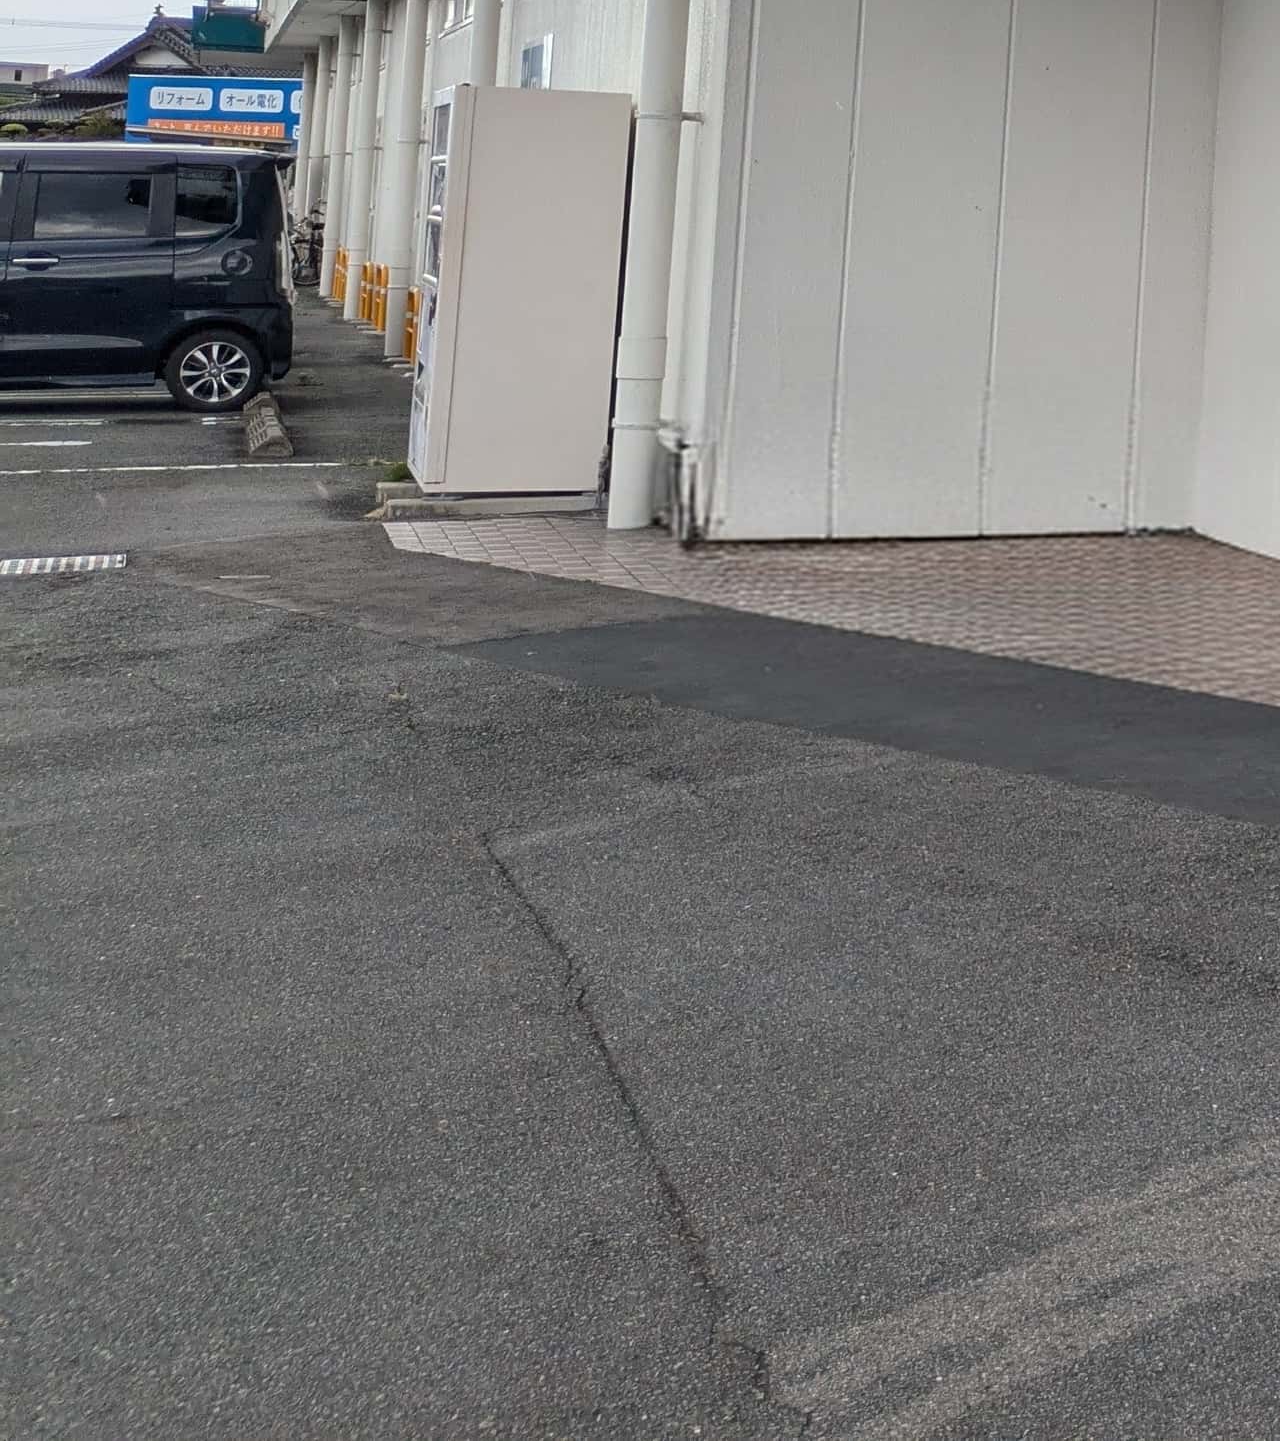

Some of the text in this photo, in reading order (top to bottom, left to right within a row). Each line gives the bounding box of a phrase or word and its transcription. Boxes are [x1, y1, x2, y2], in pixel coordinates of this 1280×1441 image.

[157, 91, 206, 106] リフォーム
[226, 93, 278, 109] オール電化
